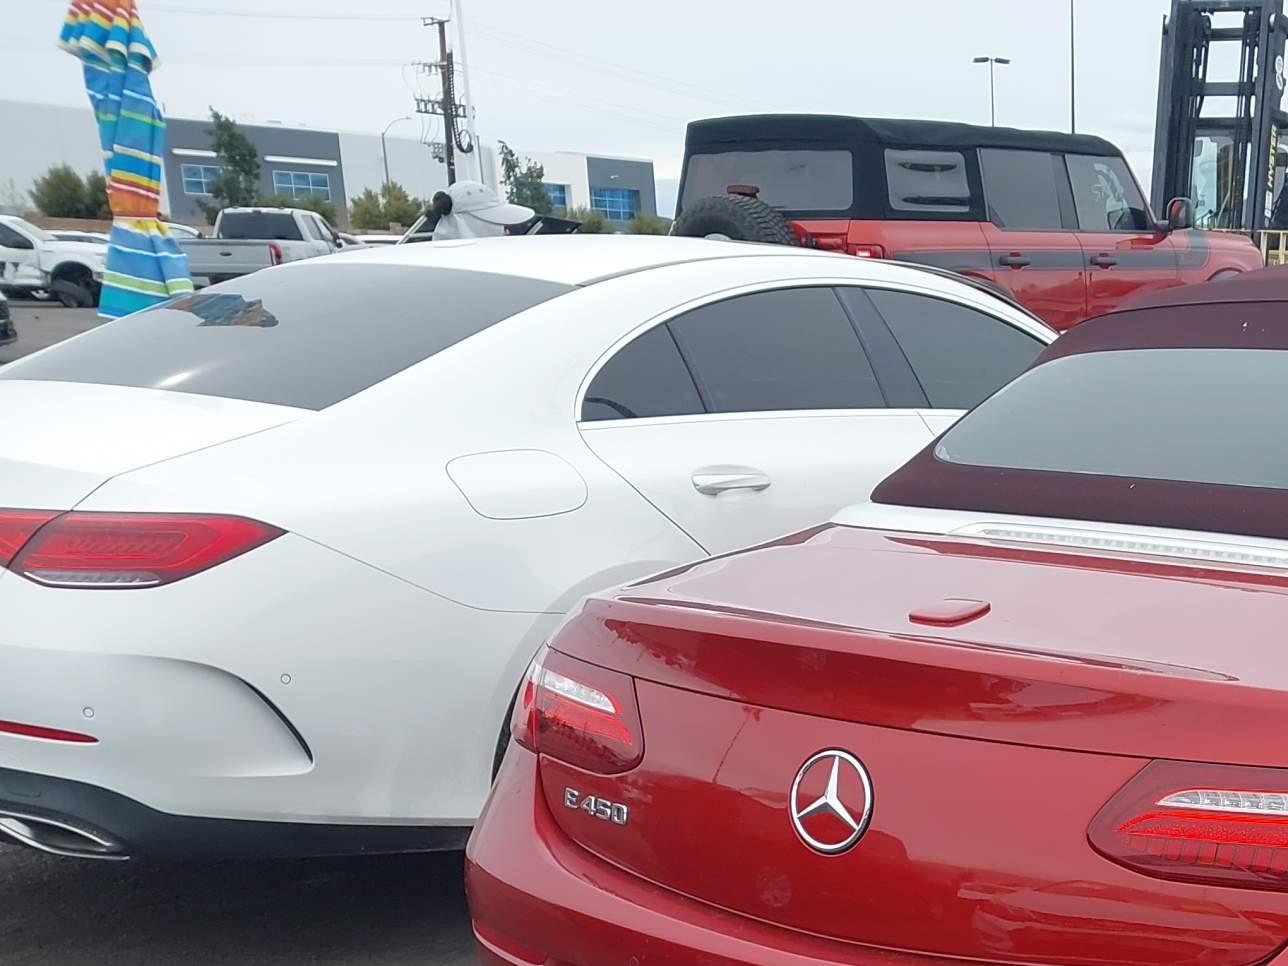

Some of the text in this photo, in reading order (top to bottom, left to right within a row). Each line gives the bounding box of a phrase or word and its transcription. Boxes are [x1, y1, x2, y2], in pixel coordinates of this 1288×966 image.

[1267, 124, 1278, 188] HYSTER
[564, 787, 628, 825] E 450
